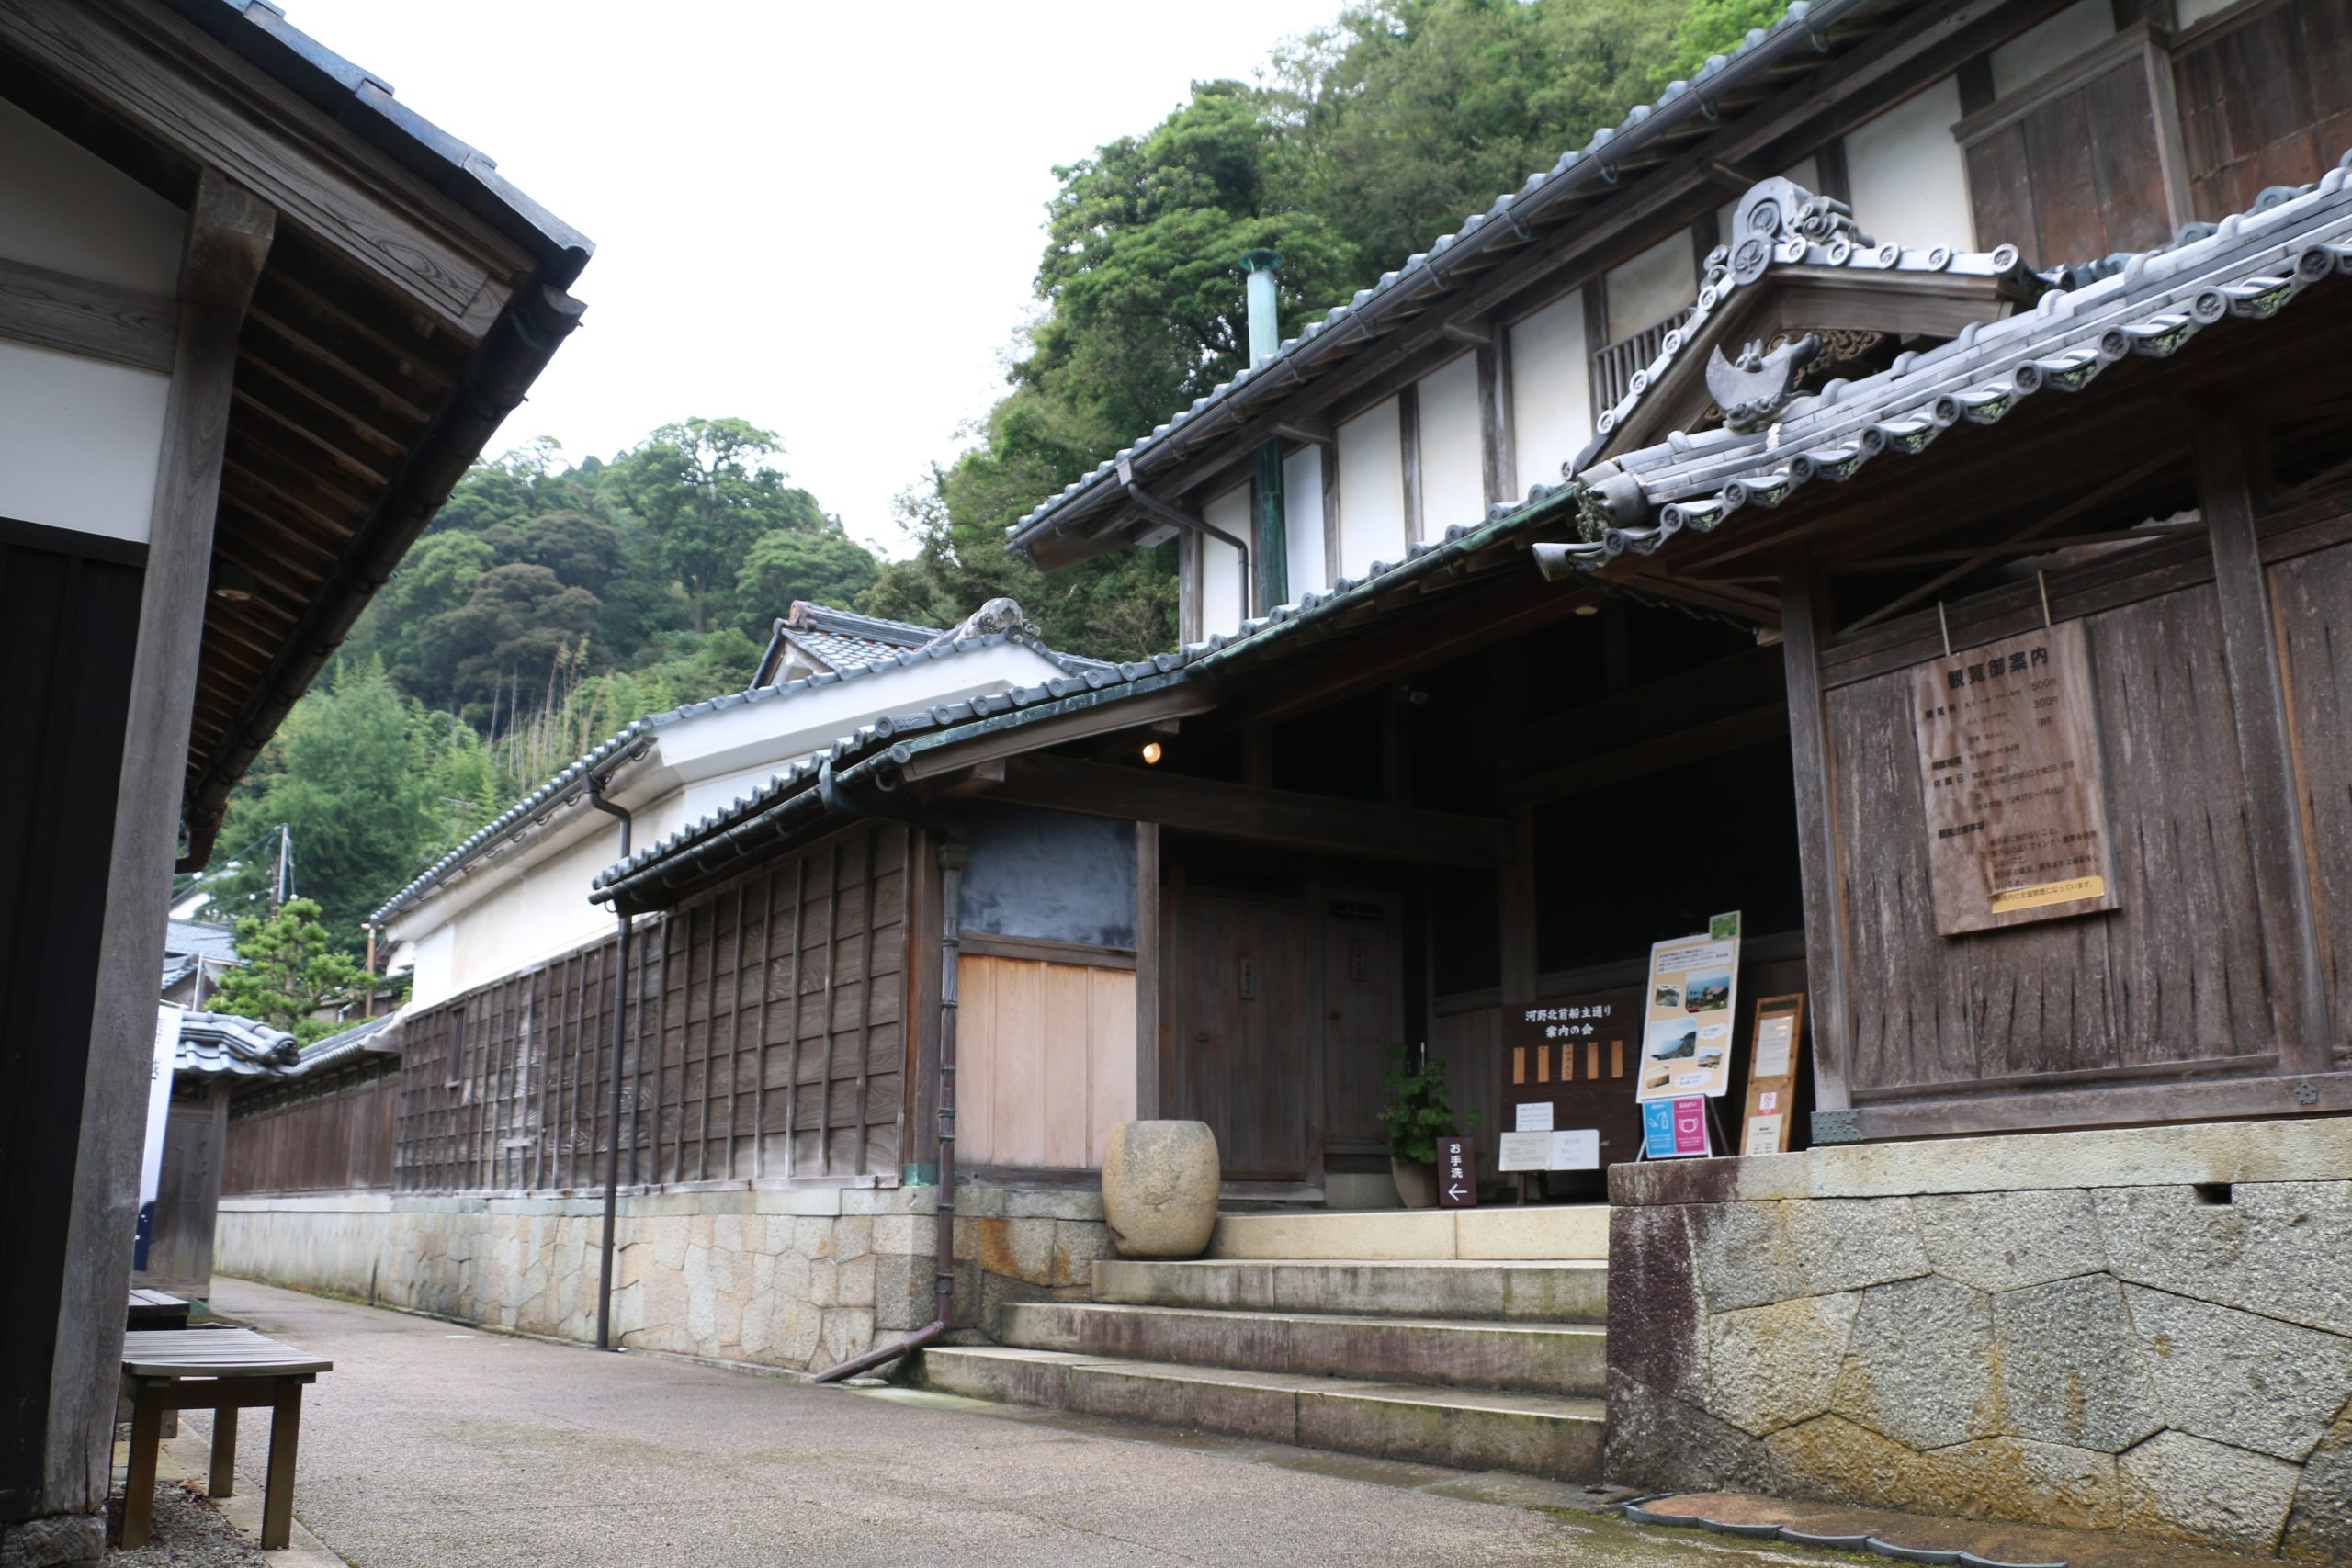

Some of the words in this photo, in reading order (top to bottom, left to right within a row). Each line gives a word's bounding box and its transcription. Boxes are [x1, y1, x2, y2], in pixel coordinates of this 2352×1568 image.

[1946, 646, 2049, 689] 観覧御案内
[2030, 678, 2056, 690] 500円
[2033, 696, 2058, 707] 300円
[1525, 1005, 1611, 1021] 河野北前船主通り
[1545, 1023, 1594, 1038] 案内の会
[1449, 1142, 1464, 1179] お手洗
